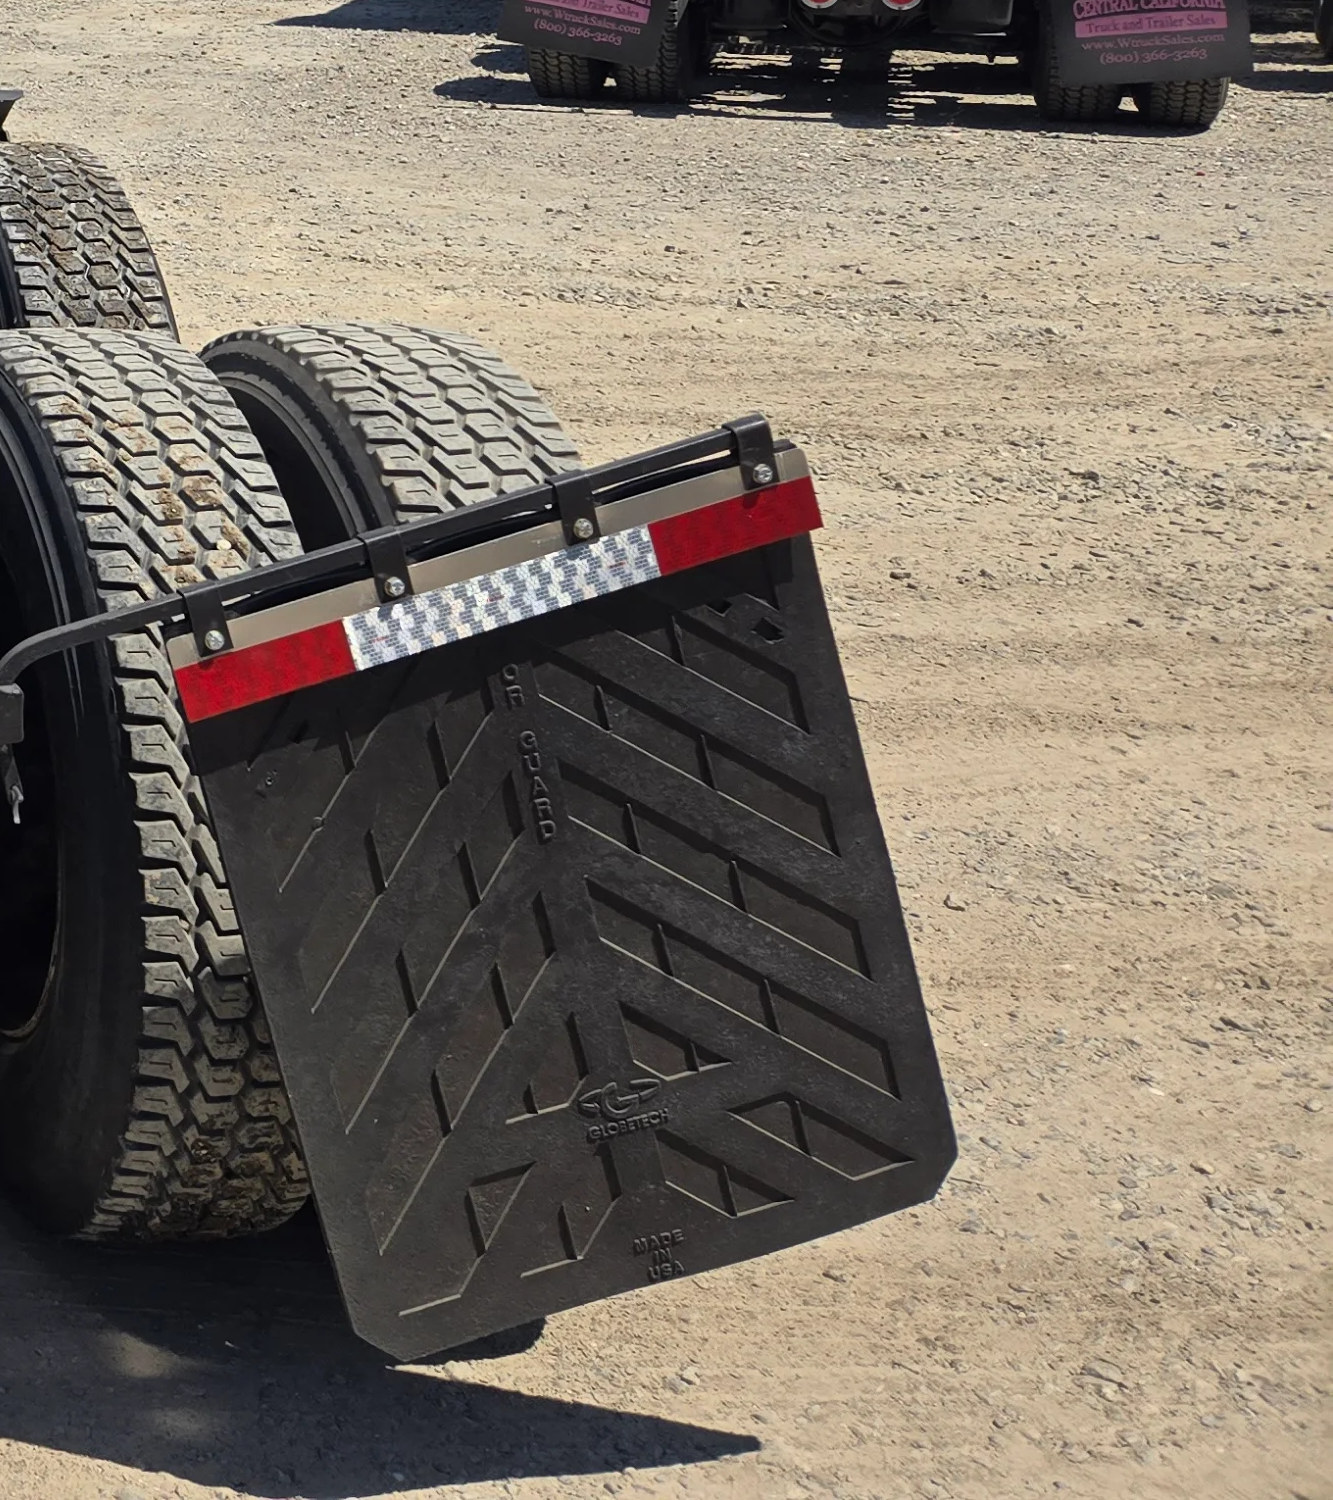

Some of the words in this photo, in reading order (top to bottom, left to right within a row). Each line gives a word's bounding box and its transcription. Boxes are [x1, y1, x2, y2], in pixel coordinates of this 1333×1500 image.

[524, 4, 641, 35] www.WtruckSales.com
[615, 3, 640, 19] Sales
[534, 18, 566, 35] (800)
[568, 26, 622, 46] 366-3263
[1086, 21, 1121, 33] Truck
[1123, 19, 1143, 30] and
[1146, 15, 1184, 29] Trailer
[1187, 13, 1216, 26] Sales
[1081, 33, 1225, 50] www.WtruckSales.com
[1099, 51, 1139, 65] (800)
[1142, 47, 1208, 63] 366-3263
[587, 1108, 670, 1142] GLOBETECH
[634, 1228, 685, 1255] MADE
[653, 1248, 674, 1263] IN
[647, 1260, 685, 1281] USA
